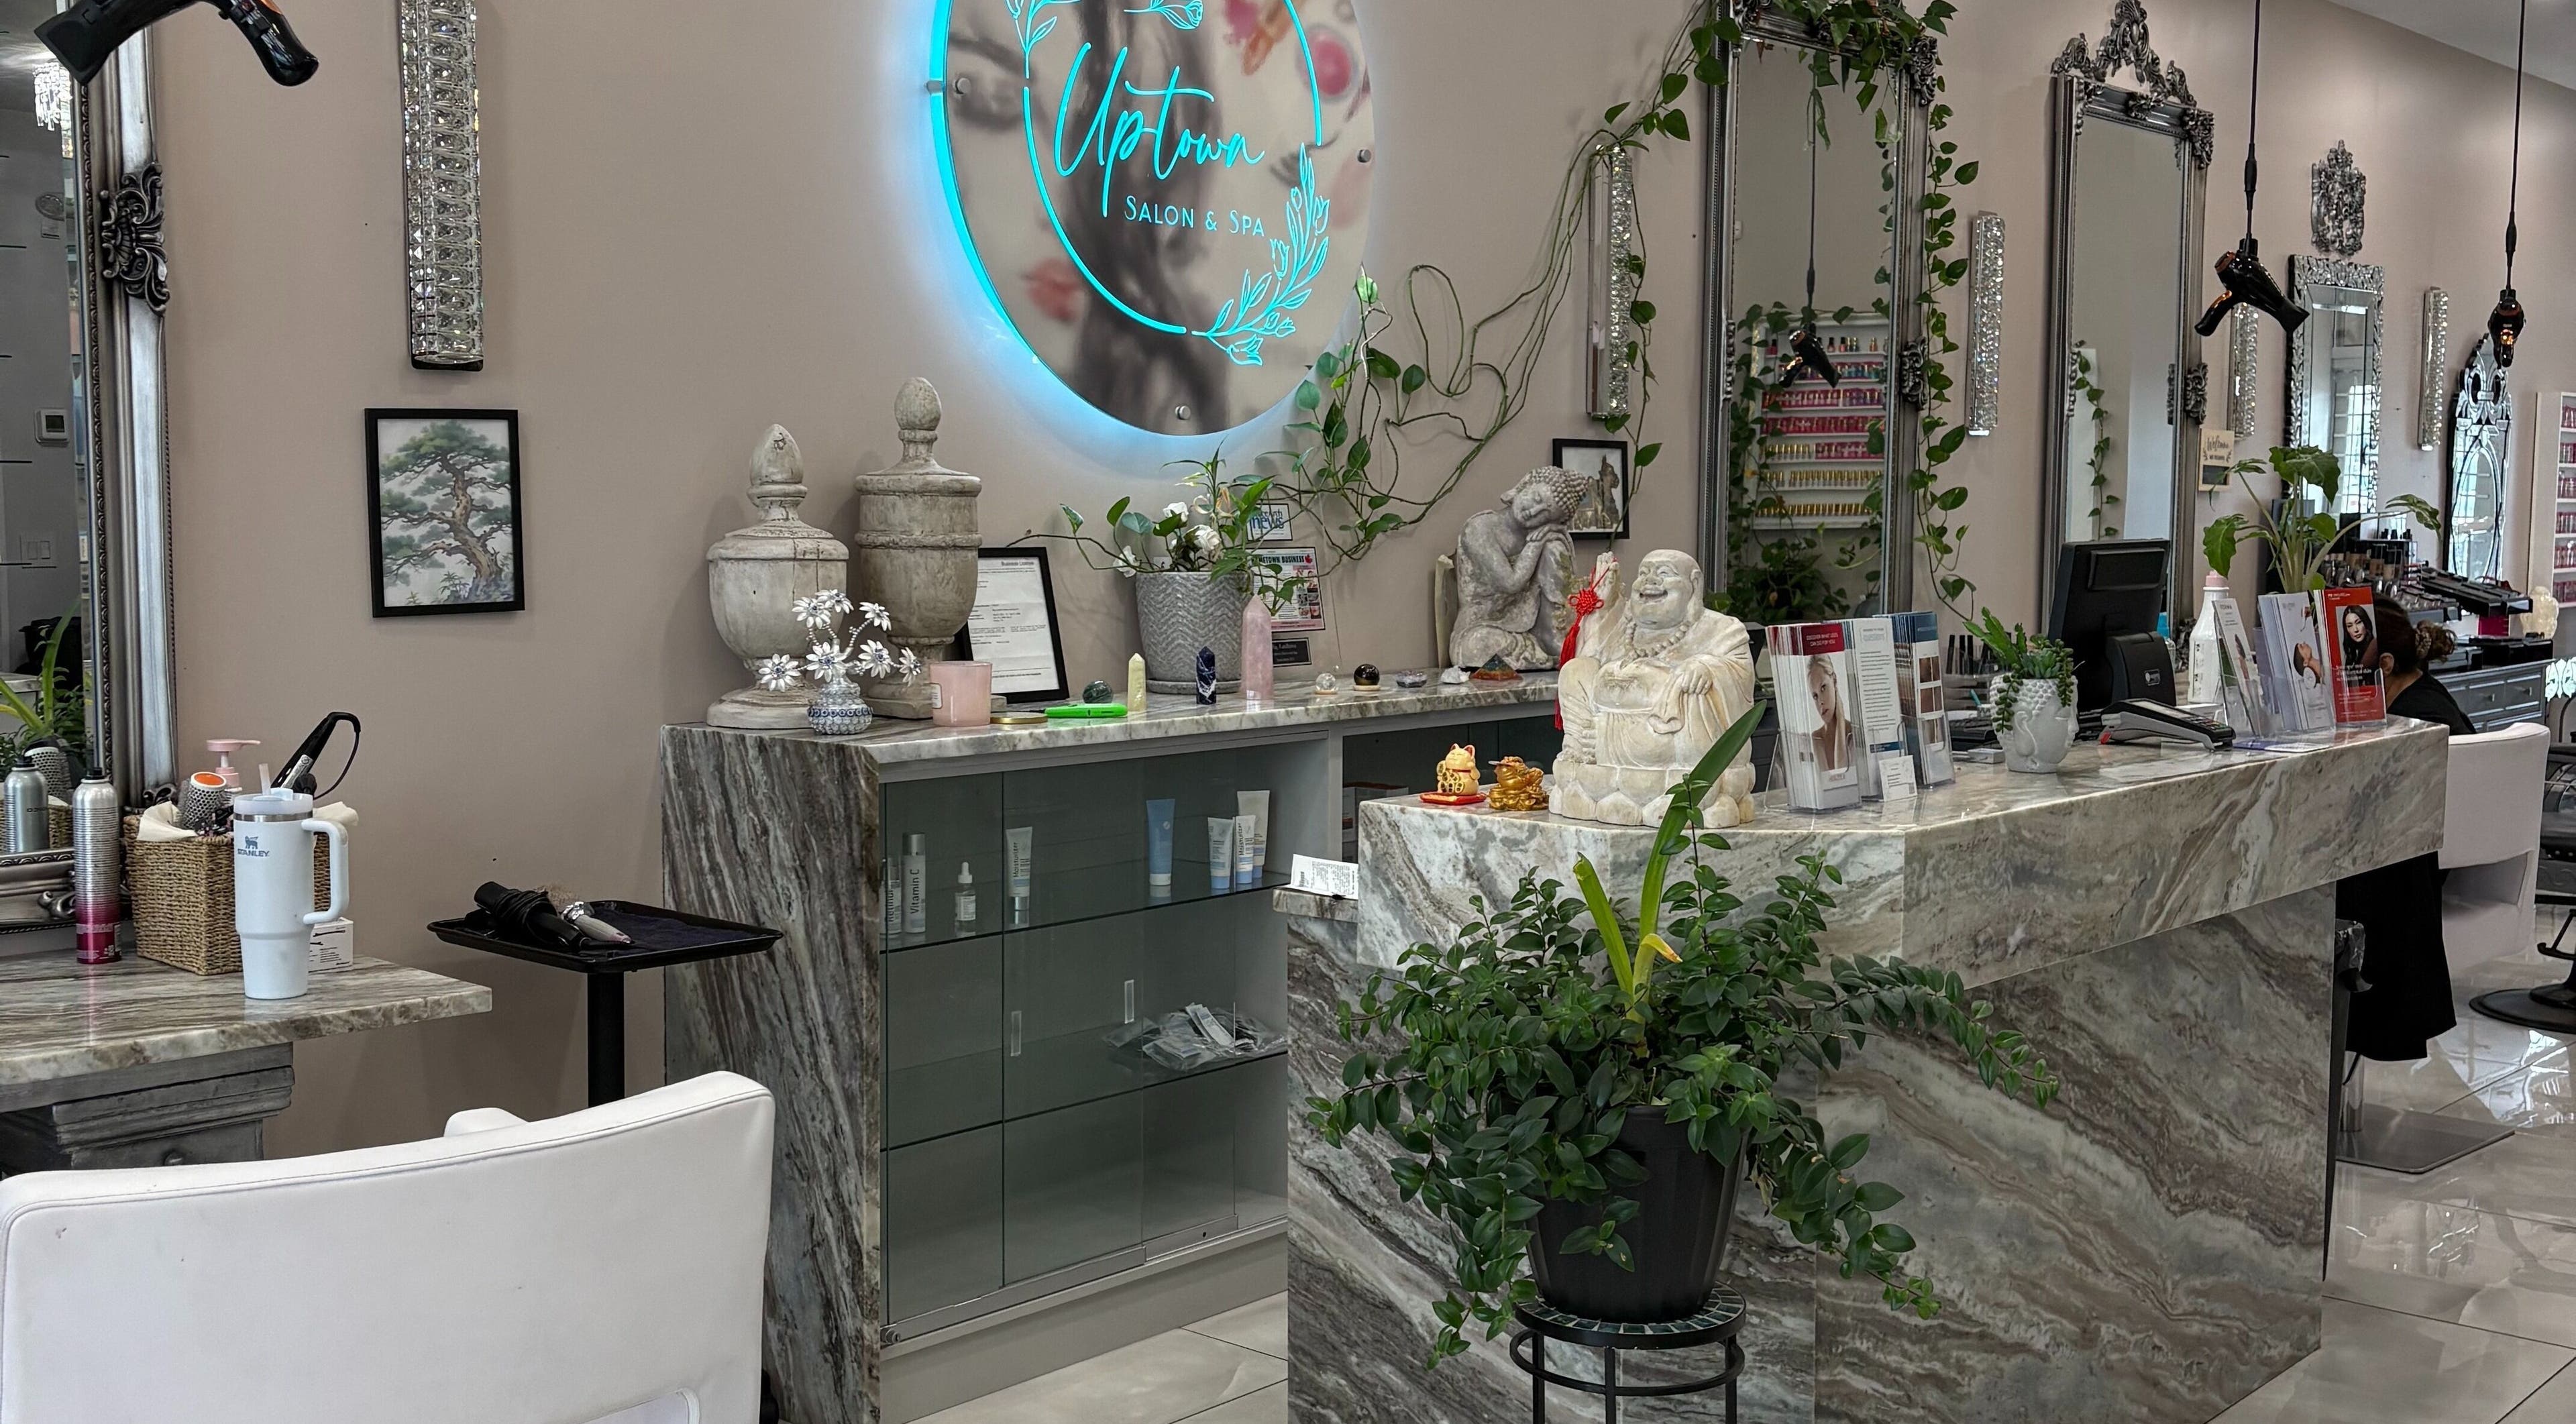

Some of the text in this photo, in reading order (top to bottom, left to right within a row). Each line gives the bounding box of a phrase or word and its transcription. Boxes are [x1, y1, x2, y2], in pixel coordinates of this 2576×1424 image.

[1054, 42, 1265, 217] Uptown
[1124, 195, 1265, 237] SALON & SPA
[1252, 516, 1284, 529] news
[1281, 555, 1304, 563] BUSINESS
[237, 848, 270, 857] STANLEY
[910, 877, 919, 914] Vitamin
